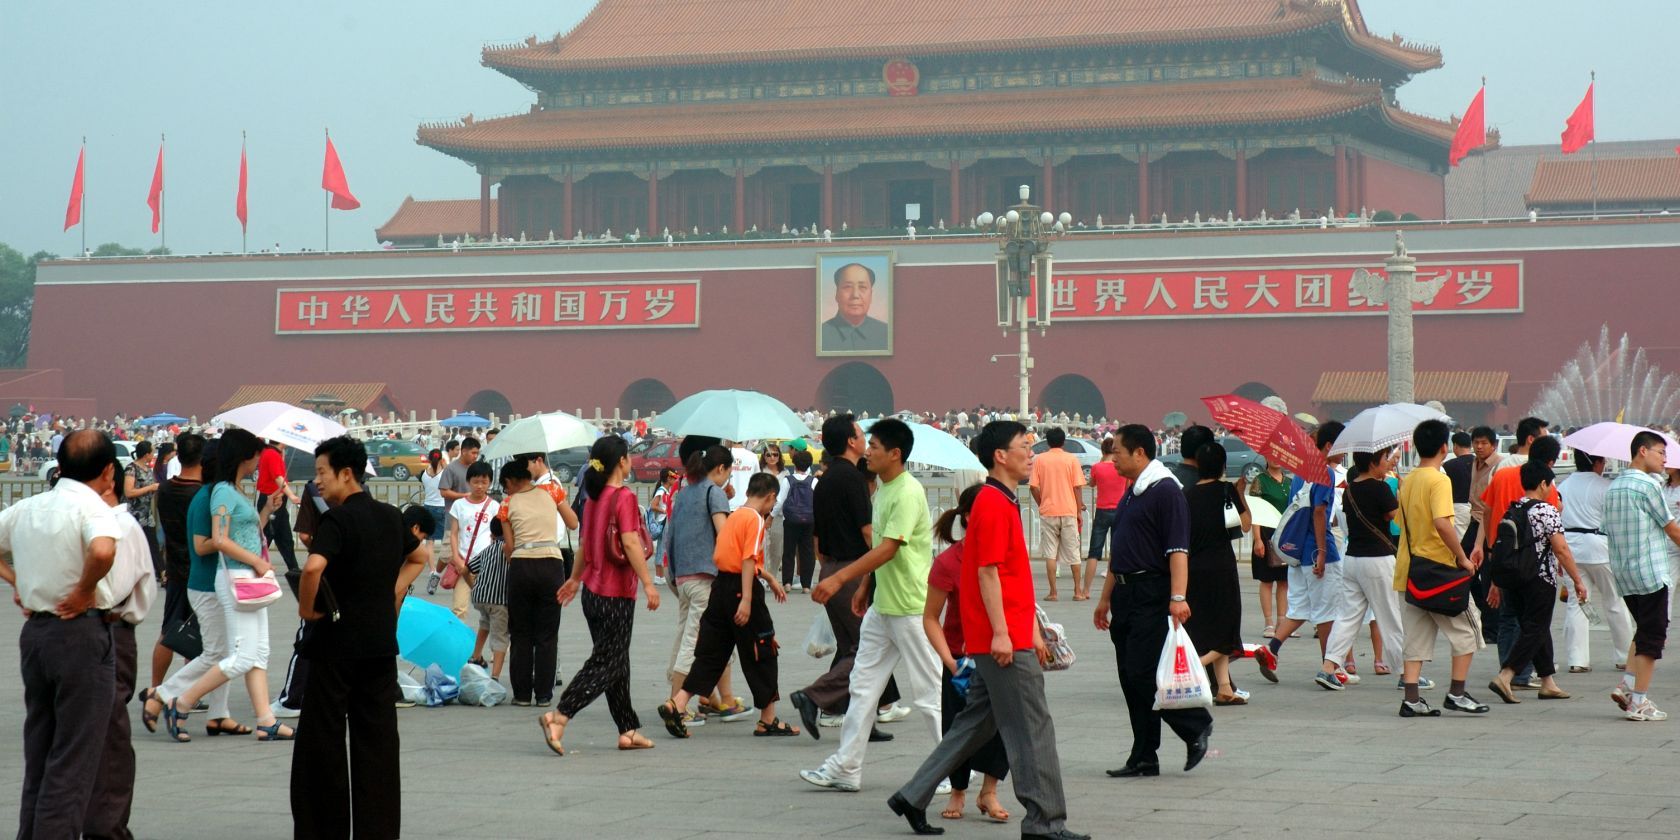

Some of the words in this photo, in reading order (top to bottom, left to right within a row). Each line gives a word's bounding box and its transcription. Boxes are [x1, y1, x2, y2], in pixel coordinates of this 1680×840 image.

[298, 288, 676, 327] 中华人民共和国万岁
[1051, 269, 1493, 312] 世界人民大团岁
